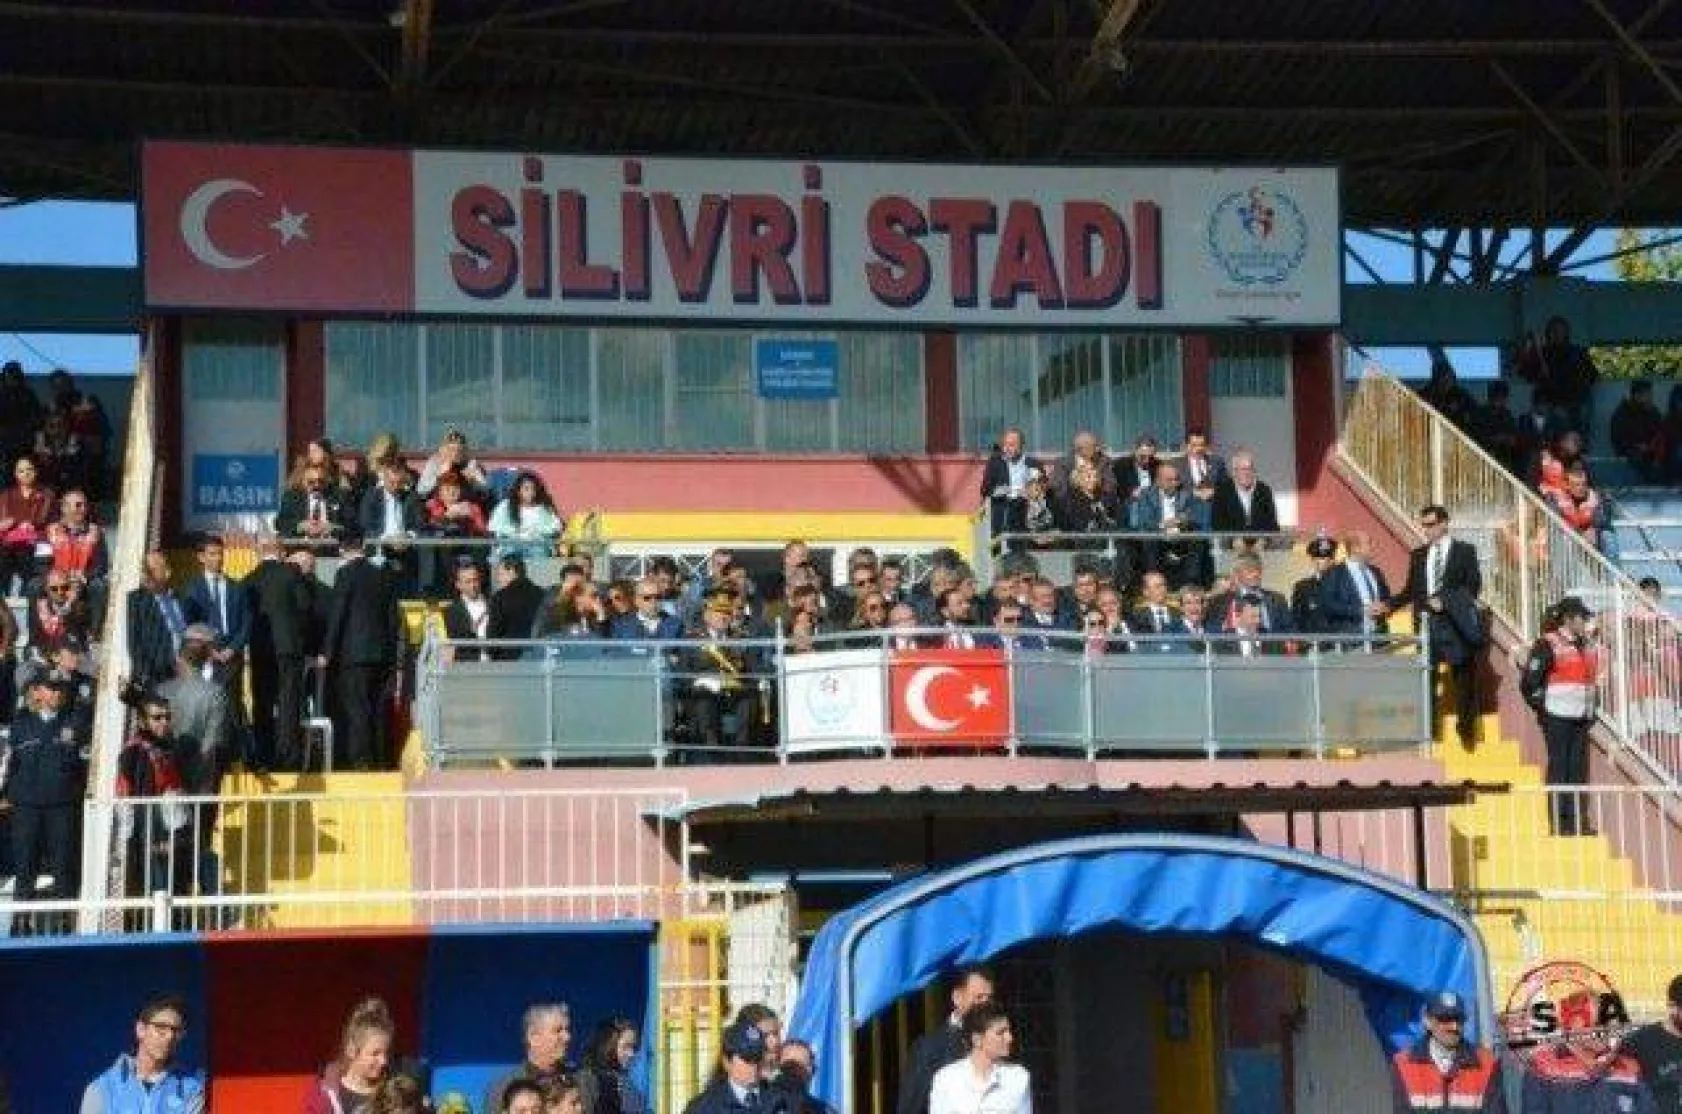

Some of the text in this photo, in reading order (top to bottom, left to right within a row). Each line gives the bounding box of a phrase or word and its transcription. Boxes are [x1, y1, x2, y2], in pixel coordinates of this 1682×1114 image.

[450, 157, 1164, 310] SİLİVRİ STADI
[199, 486, 274, 505] BASIN
